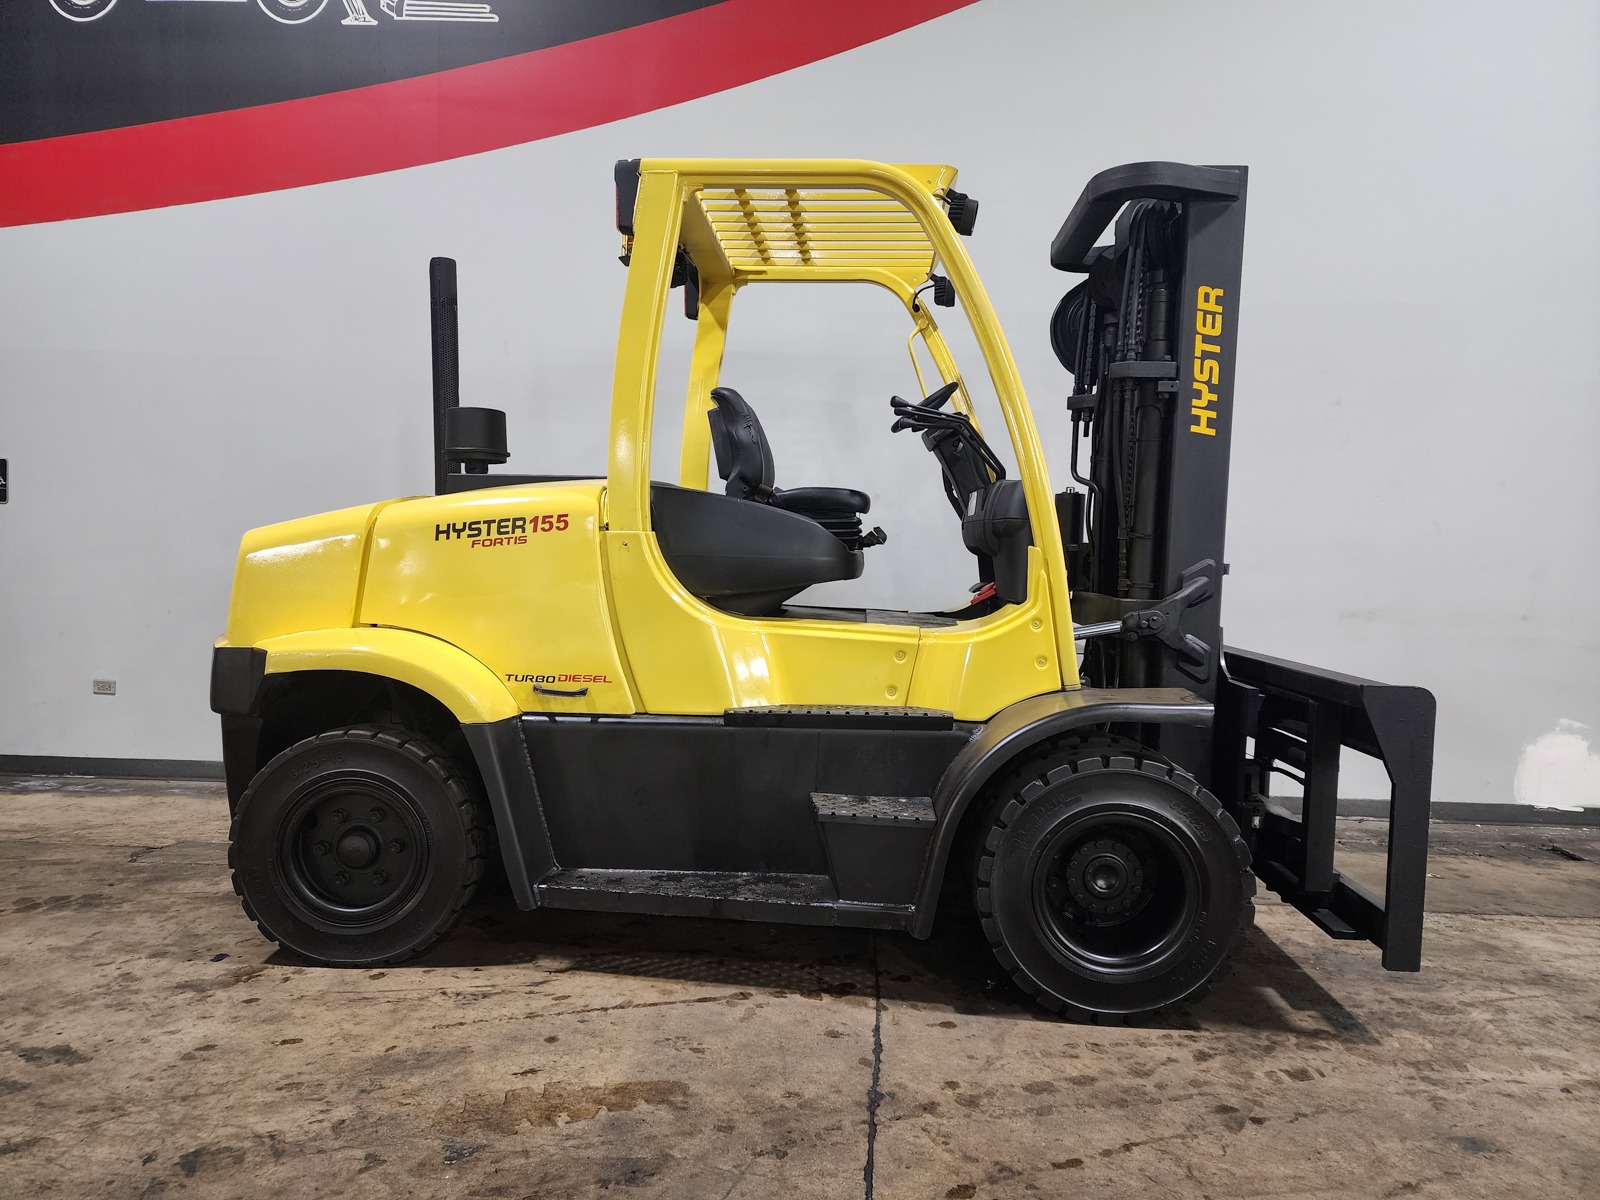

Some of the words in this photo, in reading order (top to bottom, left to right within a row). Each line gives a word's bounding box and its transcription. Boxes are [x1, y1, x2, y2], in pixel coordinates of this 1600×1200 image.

[1190, 285, 1224, 436] HYSTER
[435, 516, 527, 541] HYSTER
[529, 513, 569, 533] 155
[471, 535, 528, 548] FORTIS
[505, 673, 556, 684] TURBO
[557, 673, 612, 684] DIESEL
